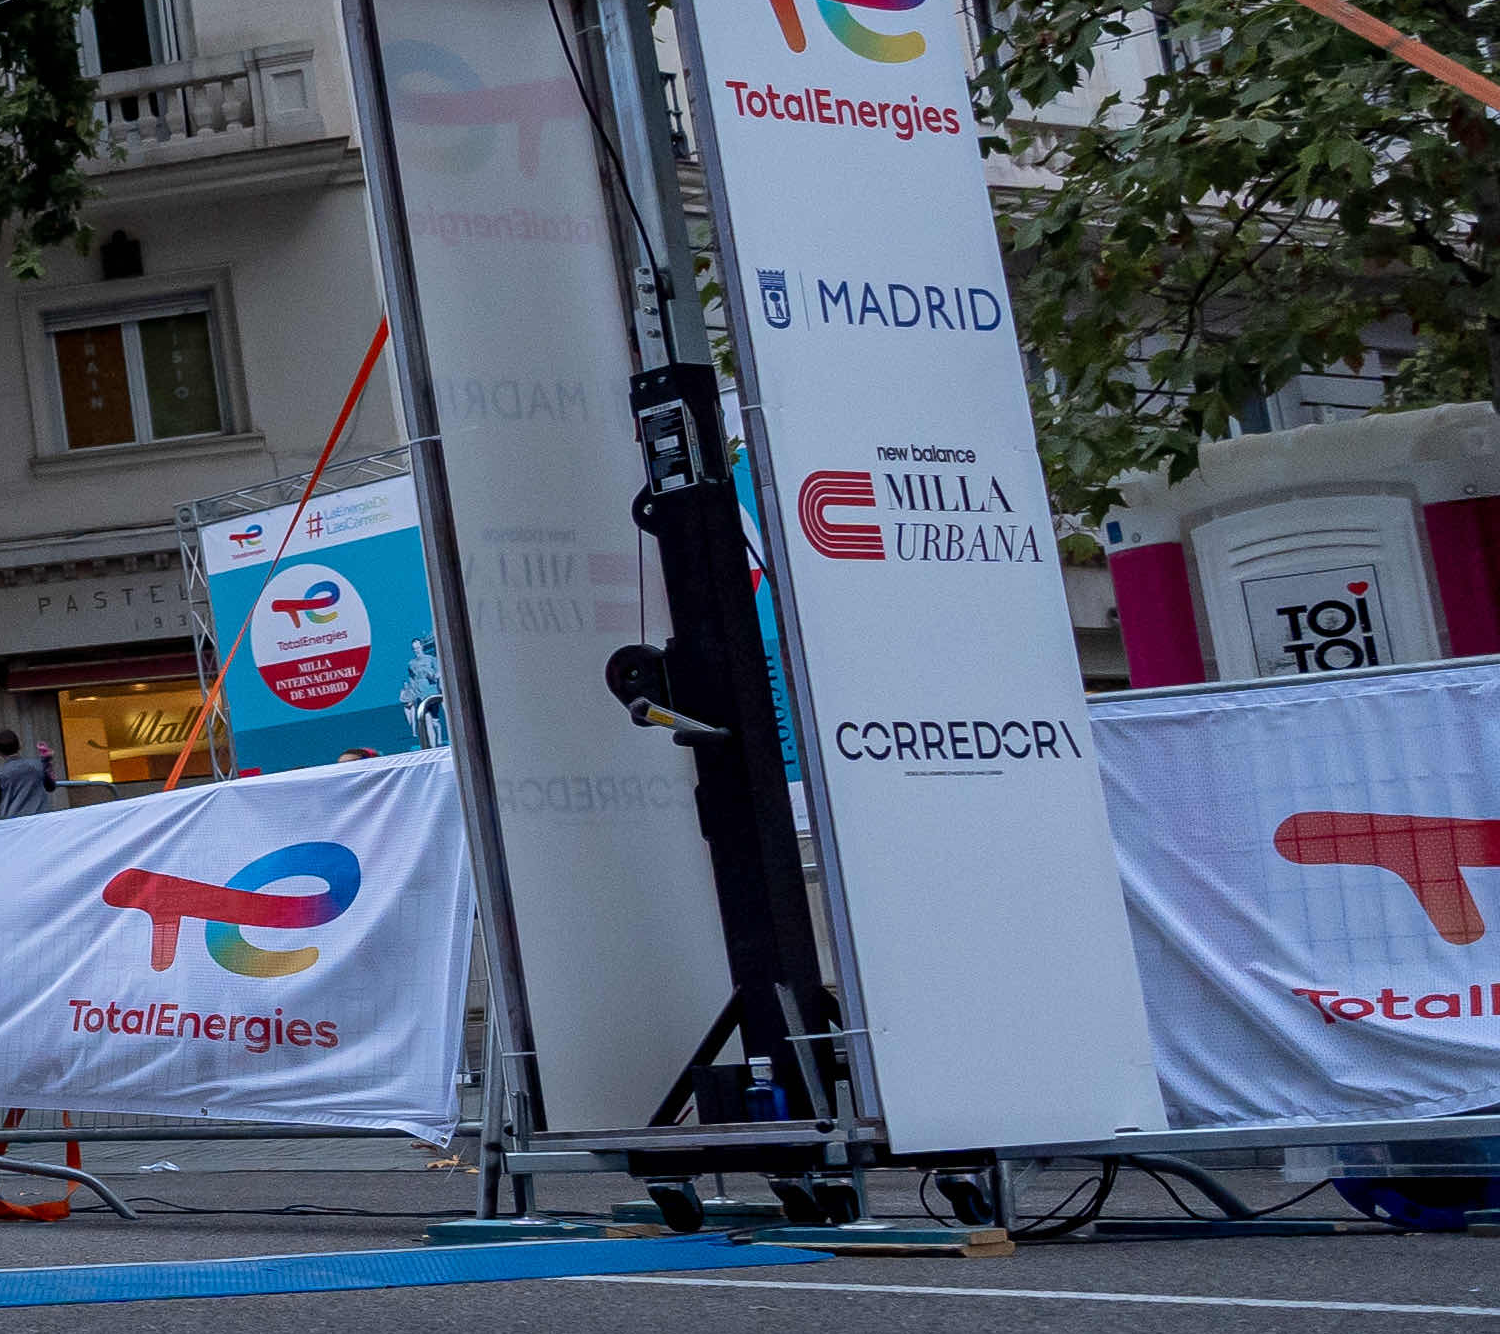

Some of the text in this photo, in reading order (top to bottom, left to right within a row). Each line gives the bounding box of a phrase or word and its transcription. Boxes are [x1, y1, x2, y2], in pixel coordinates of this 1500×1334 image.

[725, 79, 961, 142] TotalEnergies
[817, 278, 1002, 332] MADRID
[877, 444, 977, 465] new balance
[883, 473, 1016, 514] MILLA
[893, 522, 1045, 564] URBANA
[276, 629, 349, 653] TotalEnergies
[297, 658, 333, 673] MILLA
[290, 681, 350, 701] DE MADRID
[1291, 981, 1500, 1026] Total
[68, 999, 339, 1054] TotalEnergies
